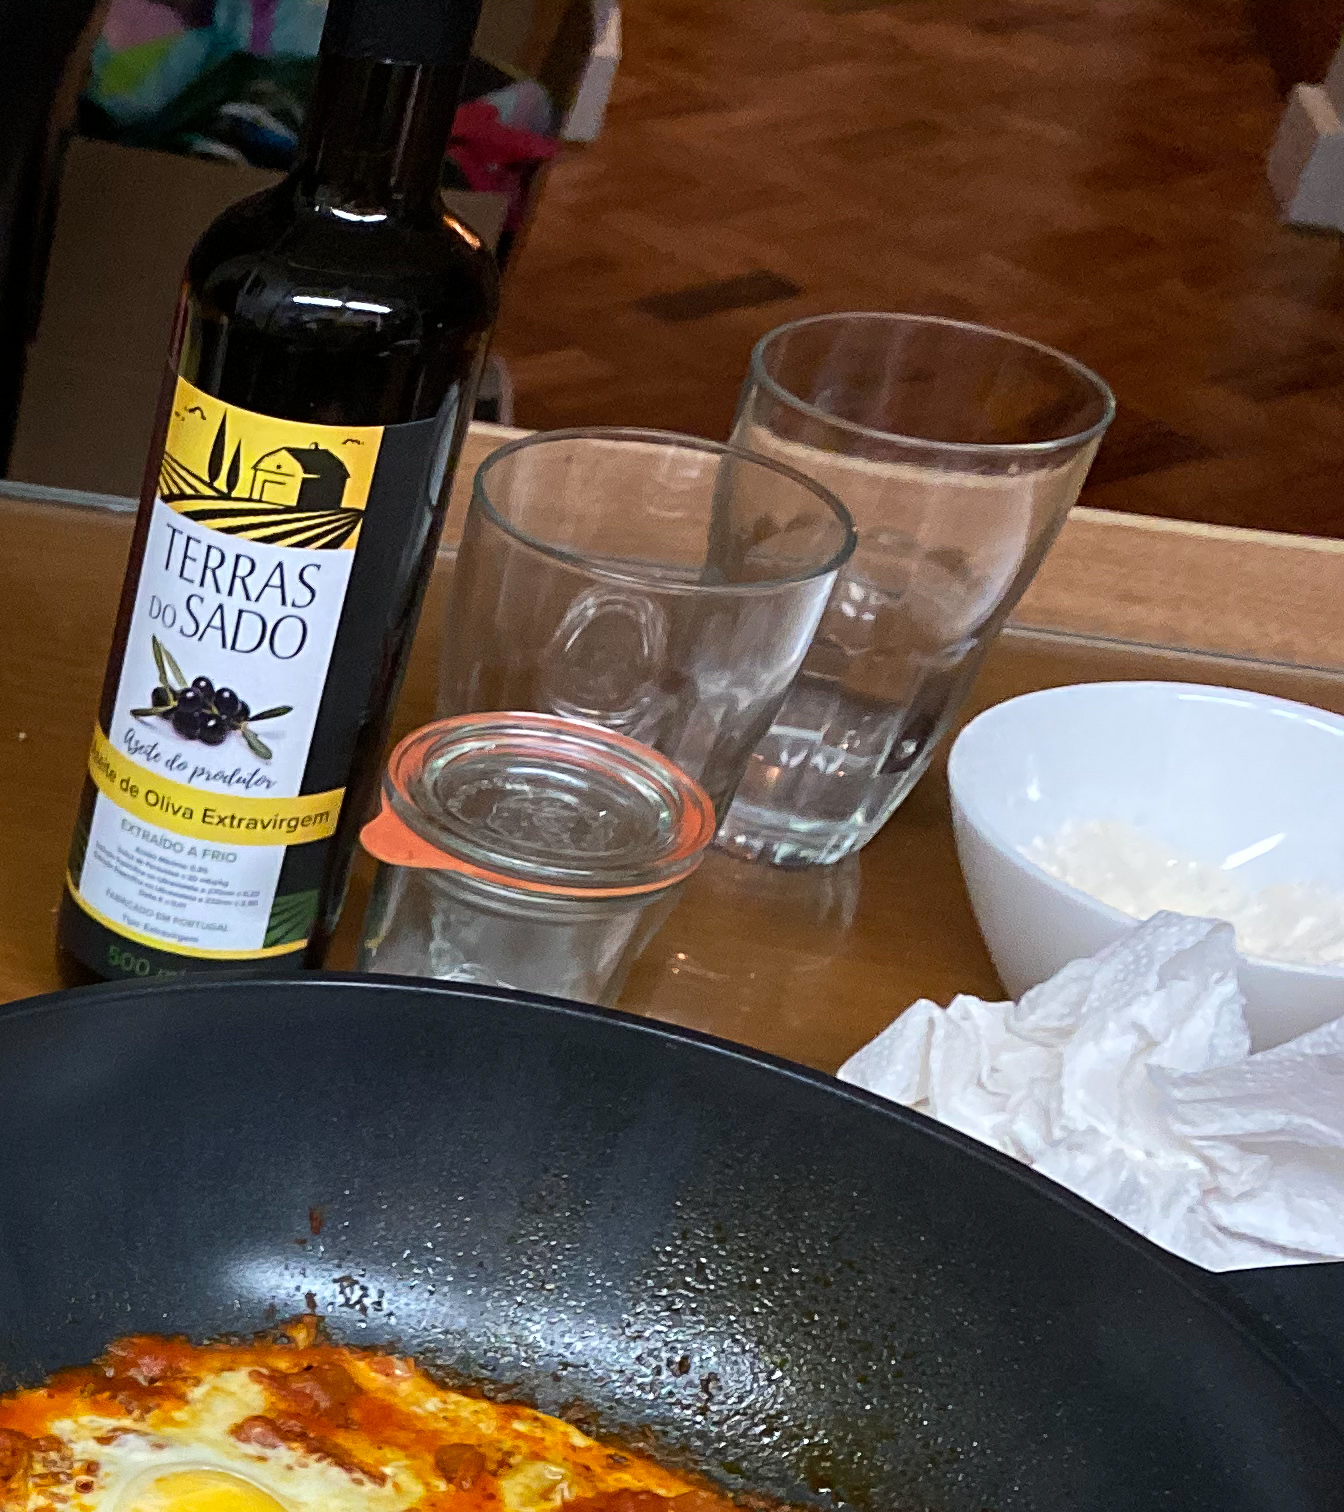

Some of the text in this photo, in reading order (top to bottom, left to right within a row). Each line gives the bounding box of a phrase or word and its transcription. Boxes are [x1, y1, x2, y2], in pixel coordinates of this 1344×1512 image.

[164, 522, 322, 609] TERRAS
[149, 593, 308, 660] DO SADO
[165, 752, 188, 771] do
[188, 766, 279, 791] produtor
[120, 776, 139, 798] de
[145, 789, 194, 820] Oliva
[201, 808, 330, 834] Extravirgem
[120, 817, 184, 854] EXTRAÍDO
[186, 846, 198, 858] A
[201, 848, 238, 864] FRIO
